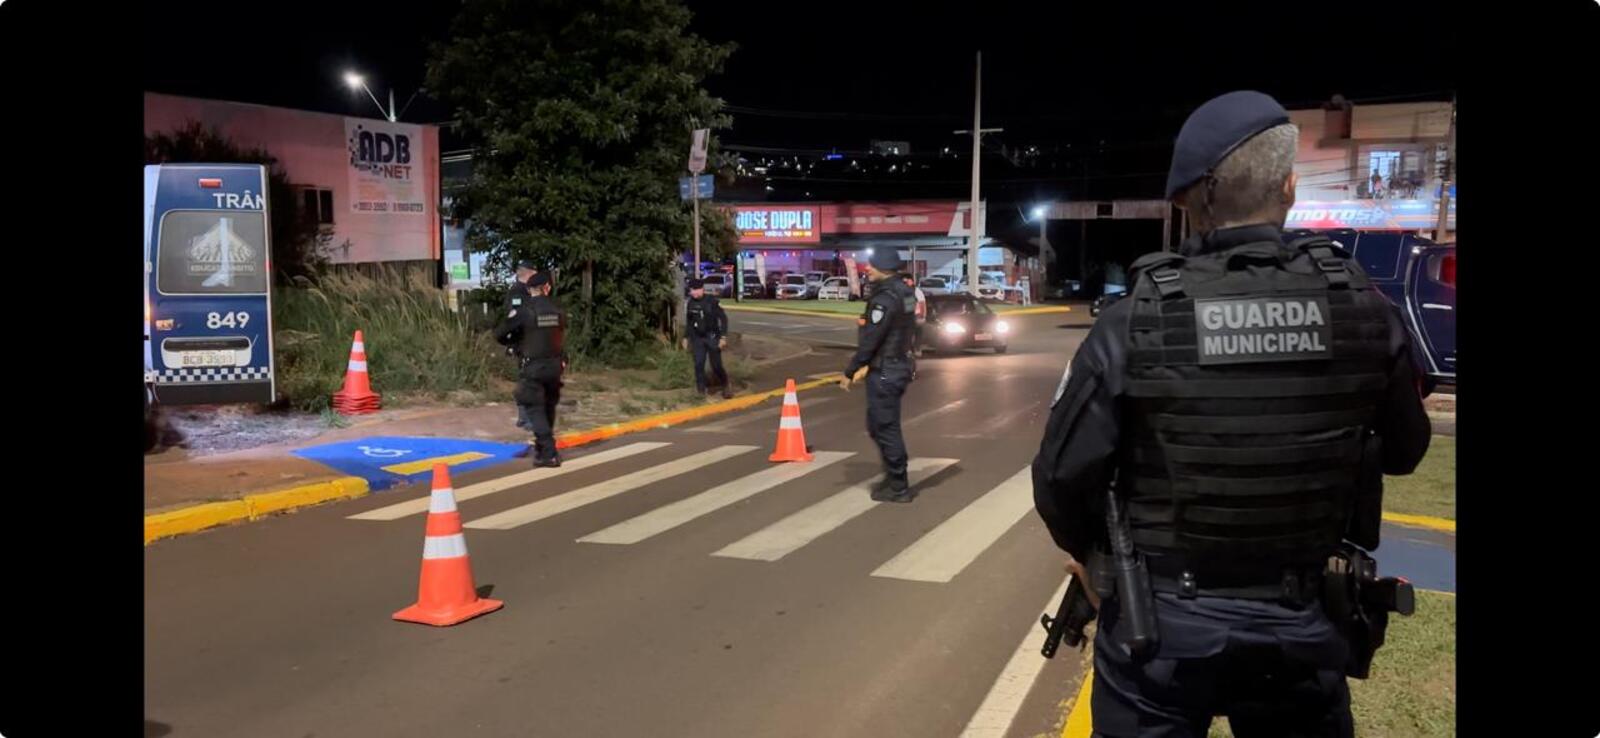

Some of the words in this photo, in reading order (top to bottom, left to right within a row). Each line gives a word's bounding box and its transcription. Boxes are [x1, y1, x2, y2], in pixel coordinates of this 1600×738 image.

[359, 131, 411, 164] ADB
[383, 165, 412, 179] NET
[770, 210, 812, 230] DUPLA
[206, 311, 250, 329] 849
[1202, 301, 1325, 330] GUARDA
[1204, 332, 1326, 355] MUNICIPAL
